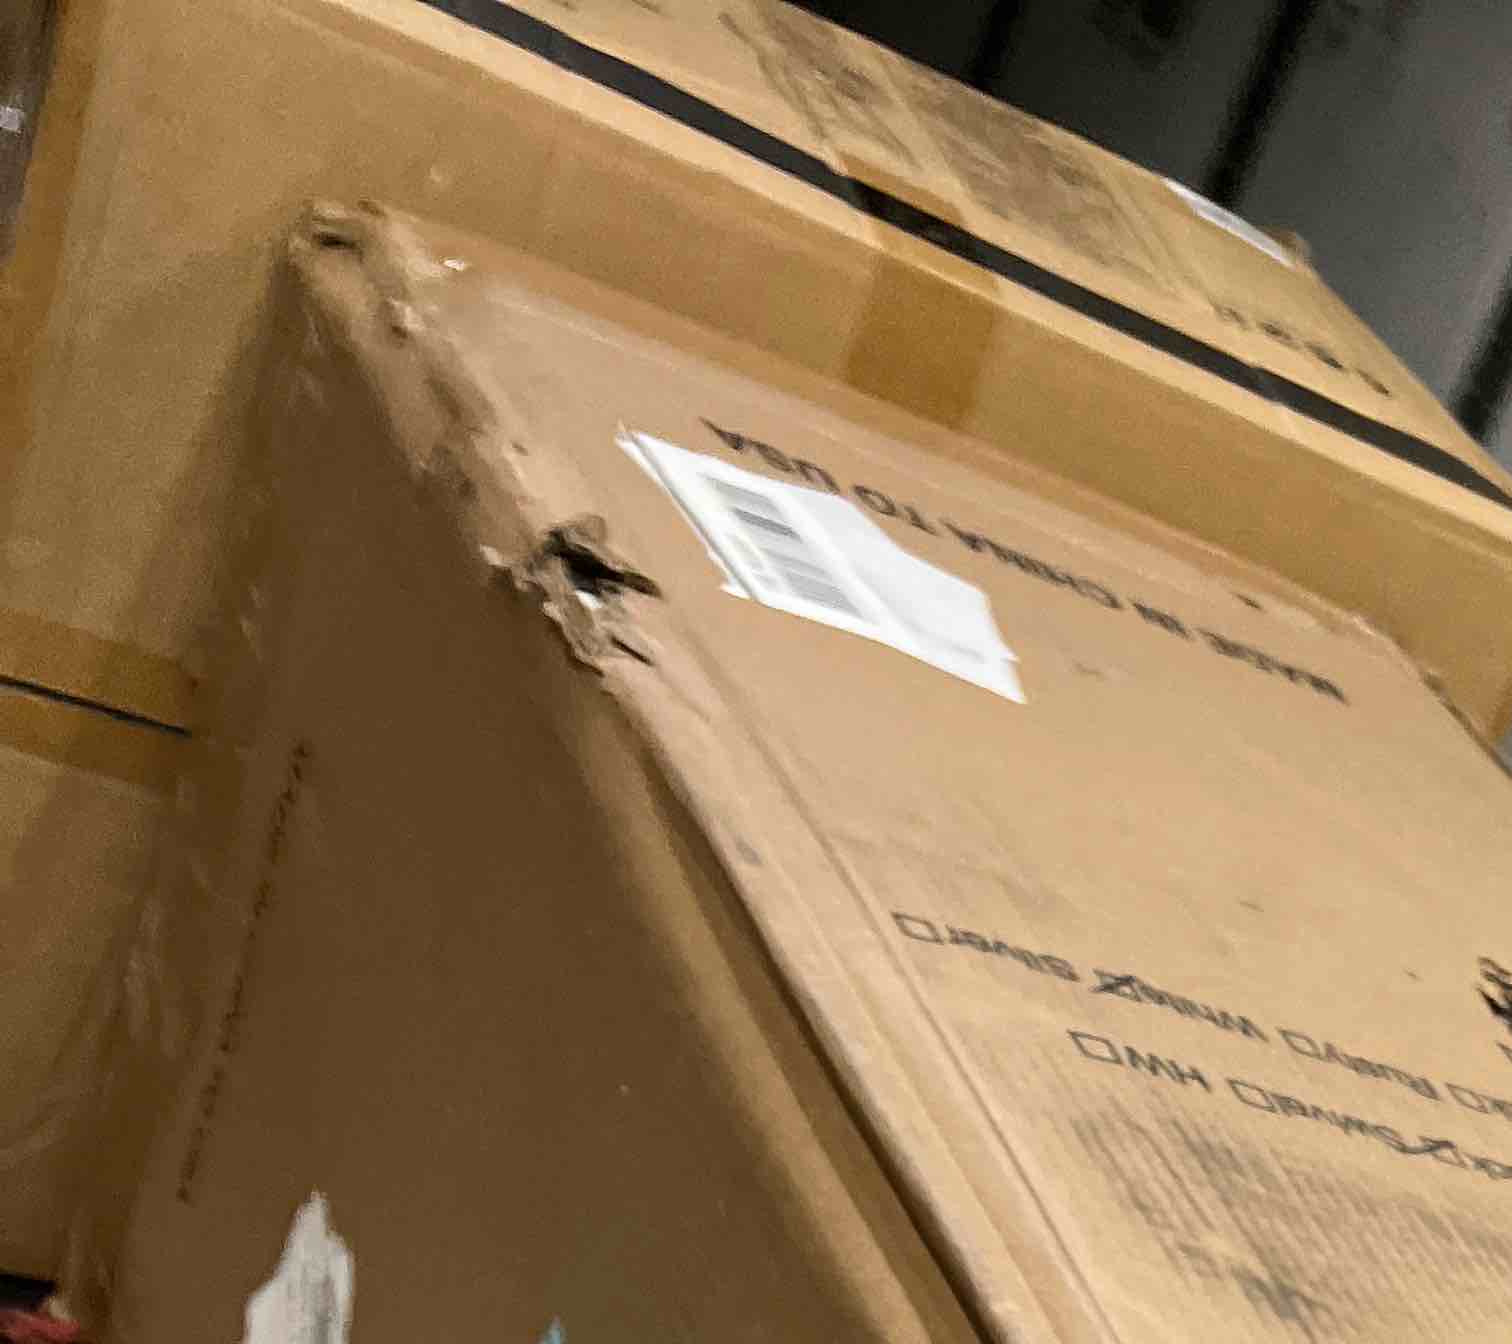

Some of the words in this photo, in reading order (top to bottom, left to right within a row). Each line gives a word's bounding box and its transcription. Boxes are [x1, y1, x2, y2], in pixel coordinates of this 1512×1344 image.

[699, 416, 842, 494] USA
[853, 484, 940, 536] TO
[938, 517, 1124, 611] CHINA
[946, 923, 1081, 982] Silver
[1124, 1046, 1212, 1093] HW
[1267, 1092, 1406, 1154] Swivel
